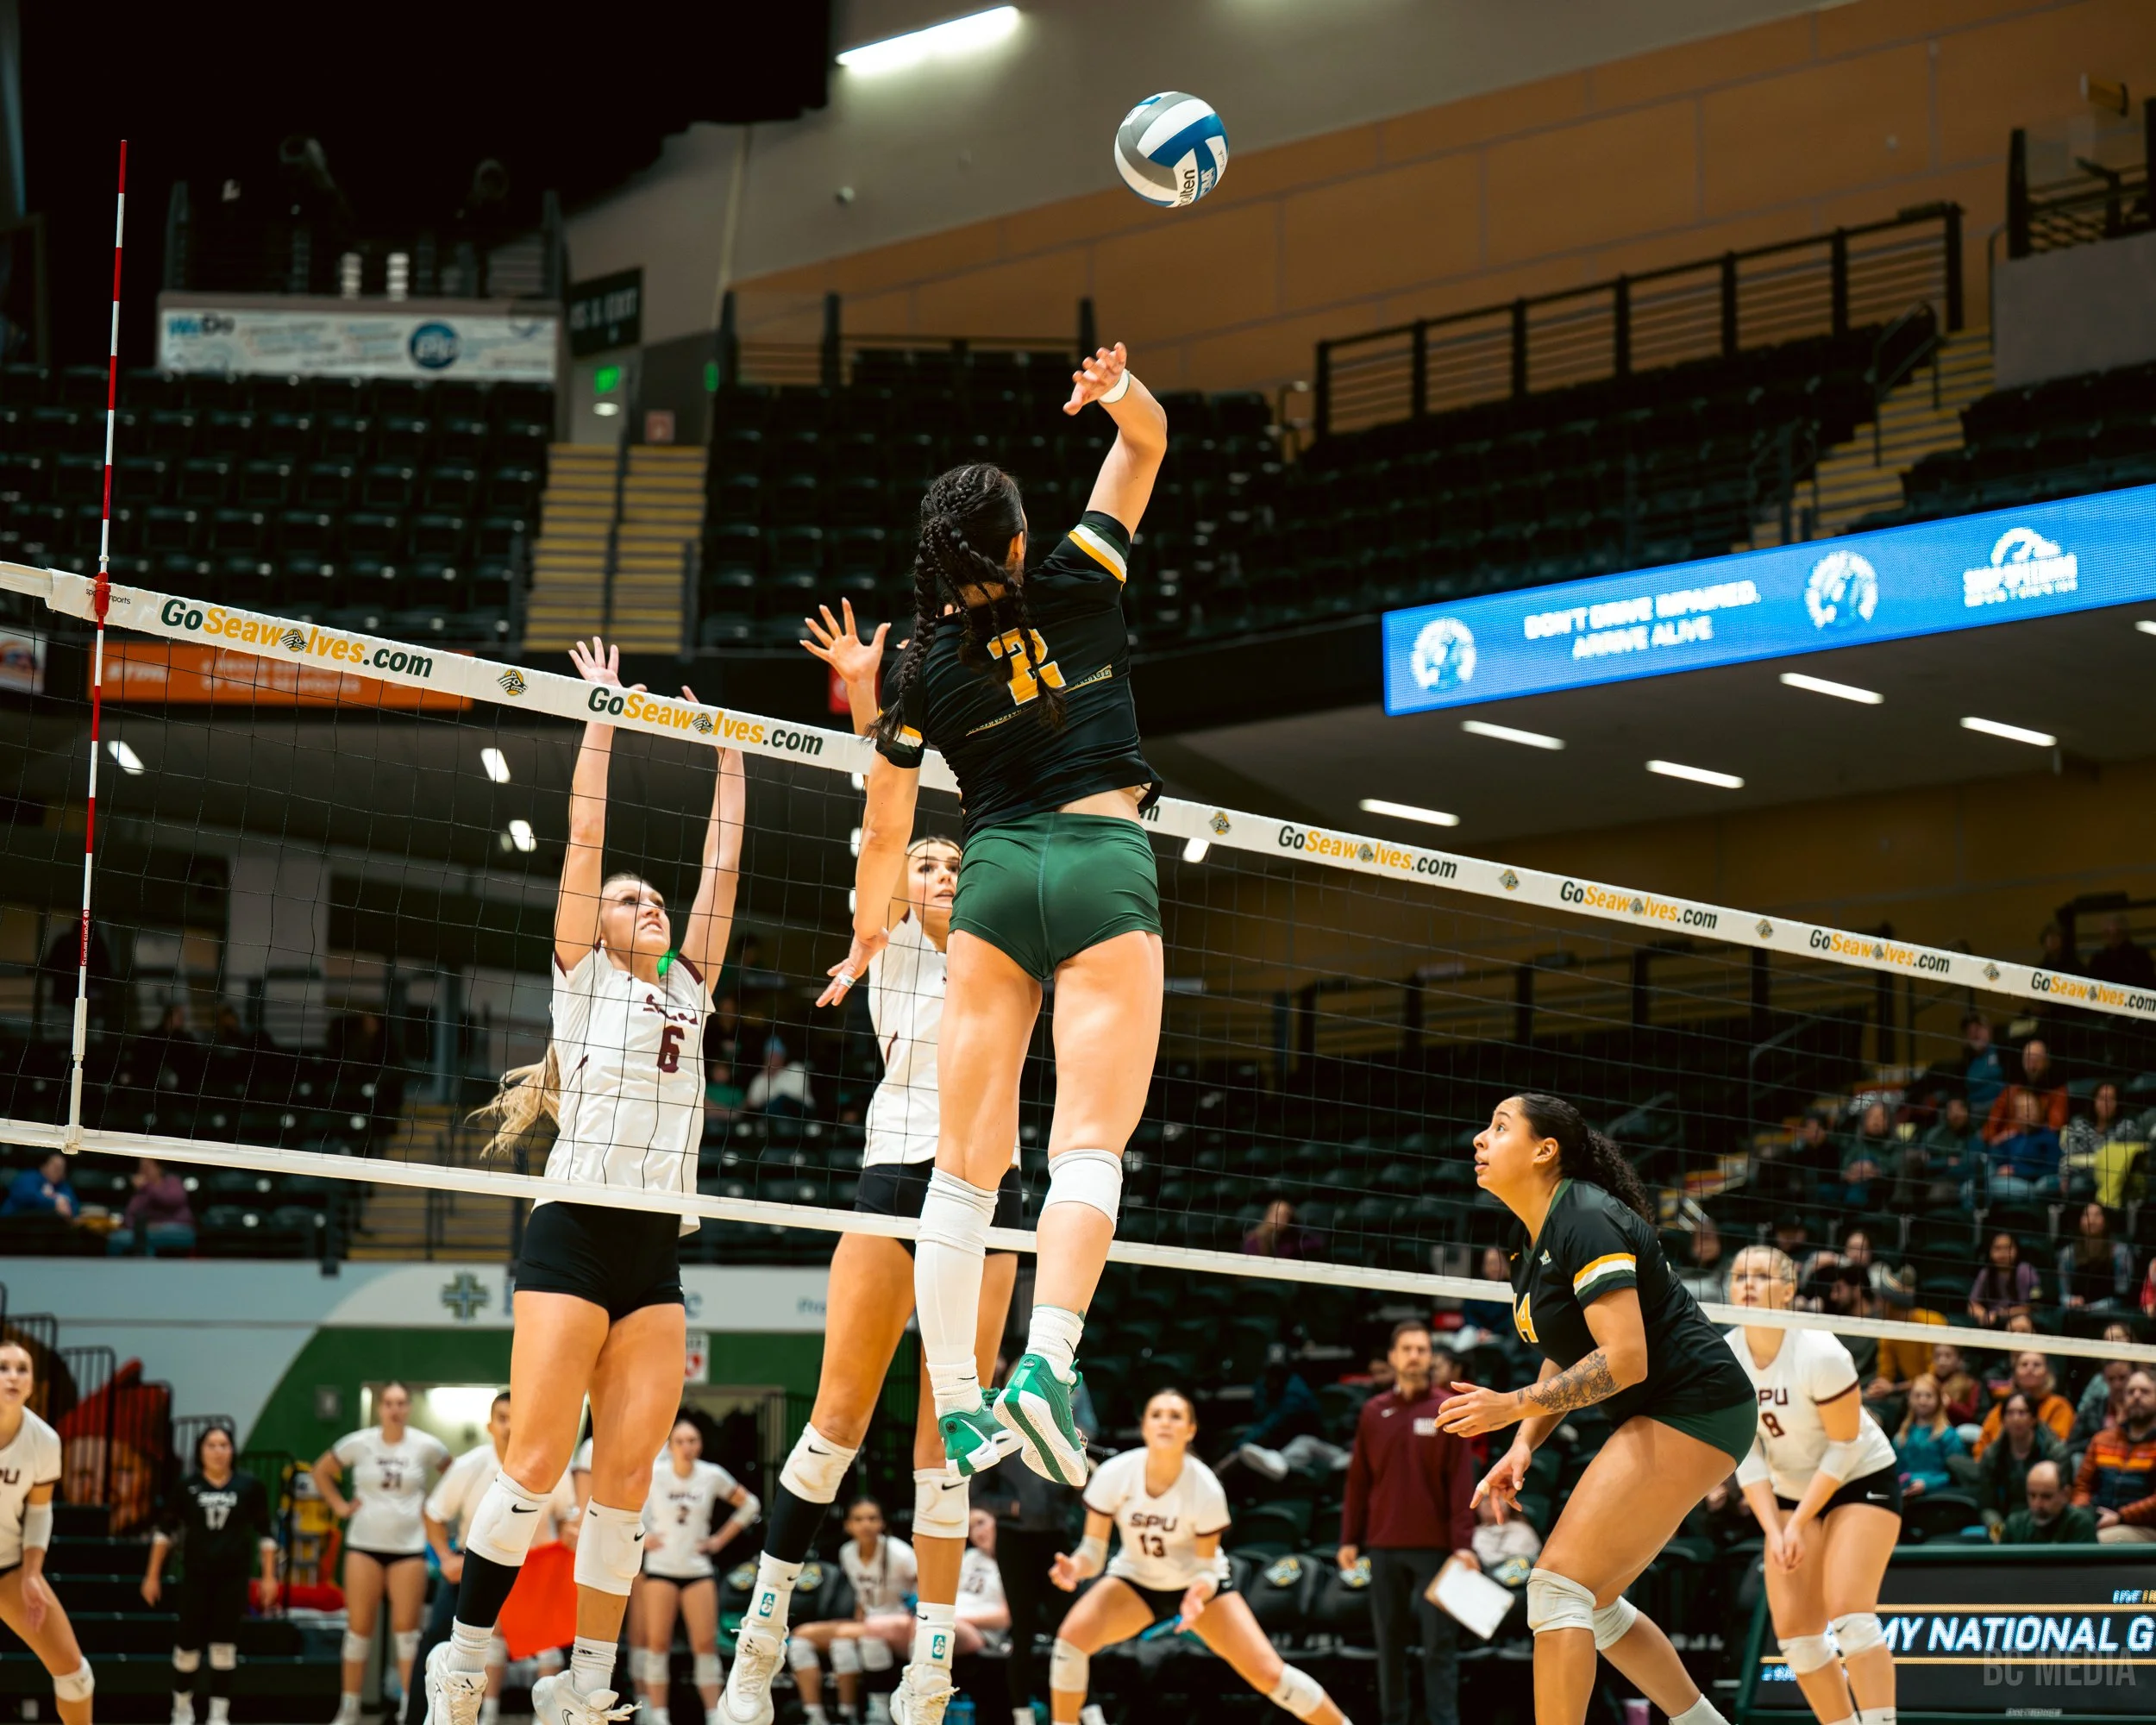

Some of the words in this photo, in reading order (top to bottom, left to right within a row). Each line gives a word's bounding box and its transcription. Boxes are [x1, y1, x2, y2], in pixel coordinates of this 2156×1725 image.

[1178, 168, 1195, 207] olten
[109, 594, 131, 605] mports
[656, 1025, 685, 1073] 6
[1758, 1388, 1789, 1407] PU
[1761, 1411, 1786, 1438] 8
[205, 1506, 231, 1531] 17
[1130, 1512, 1178, 1533] SPU
[1139, 1534, 1167, 1559] 13
[1927, 1615, 2120, 1653] NATIONAL
[2126, 1615, 2156, 1653] G
